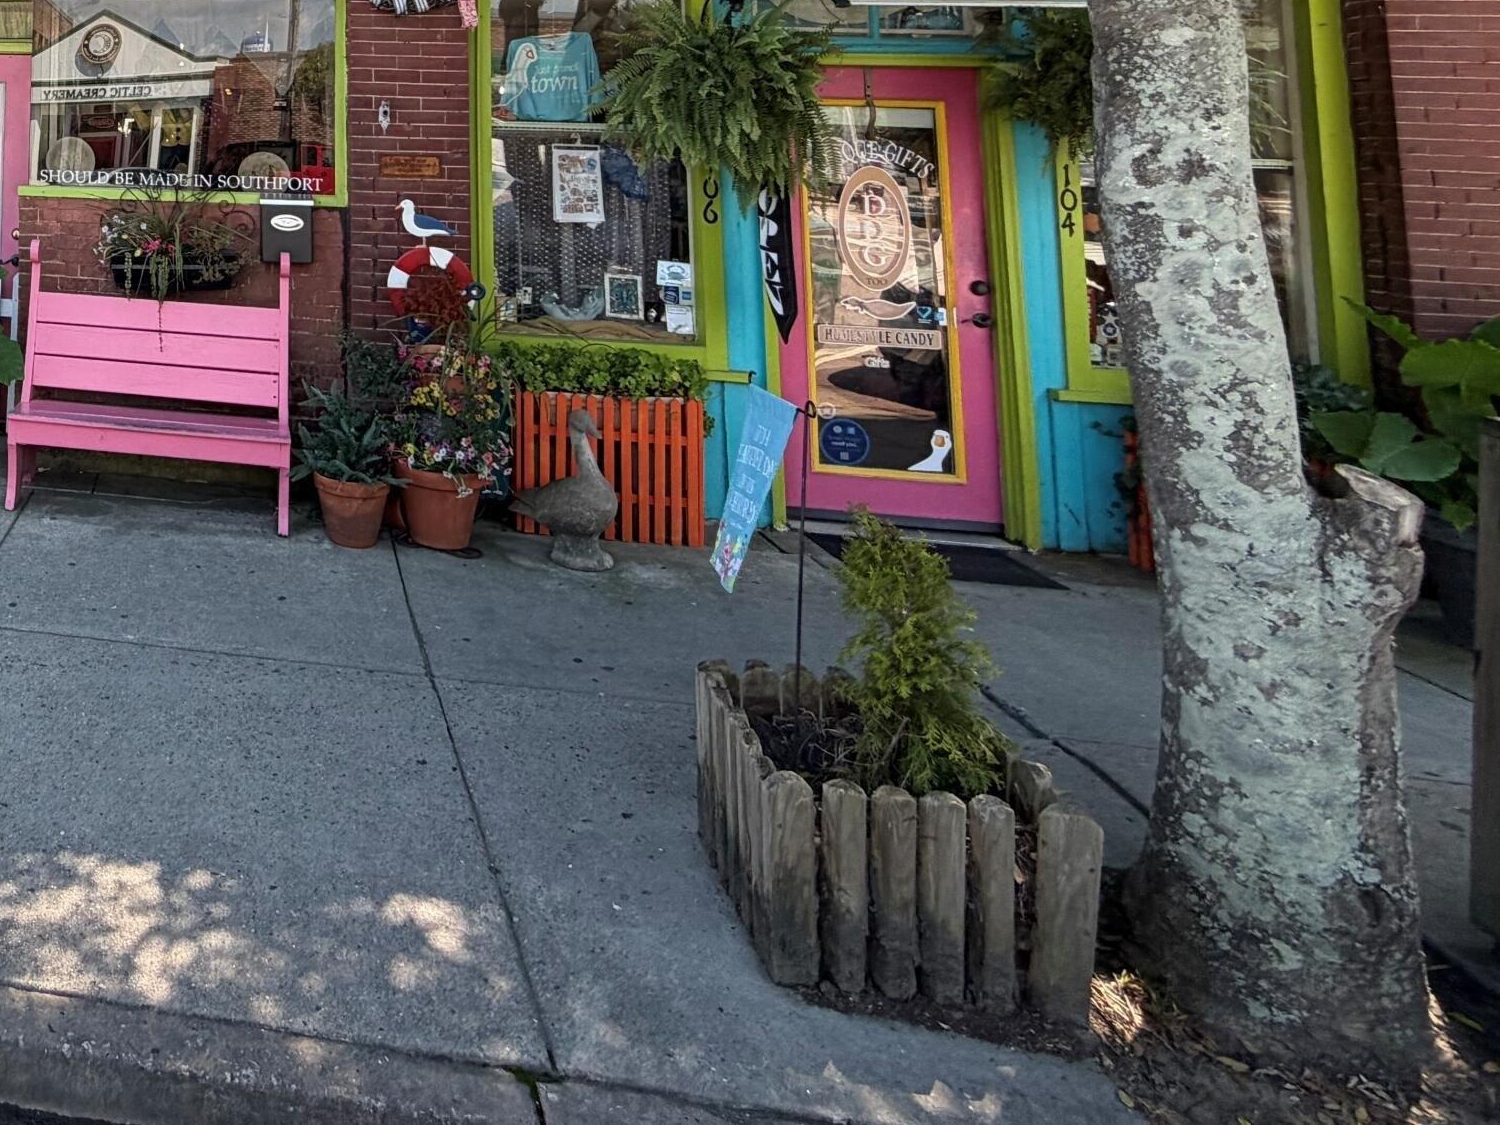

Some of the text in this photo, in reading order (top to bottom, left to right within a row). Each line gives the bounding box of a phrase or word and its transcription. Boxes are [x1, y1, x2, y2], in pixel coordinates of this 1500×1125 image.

[531, 75, 578, 93] town
[883, 139, 935, 179] GIFTS
[40, 169, 324, 191] SHOULD BE MADE IN SOUTHPORT
[703, 167, 719, 224] 06
[1060, 163, 1078, 238] 104
[865, 277, 888, 286] TOO
[896, 331, 934, 346] CANDY
